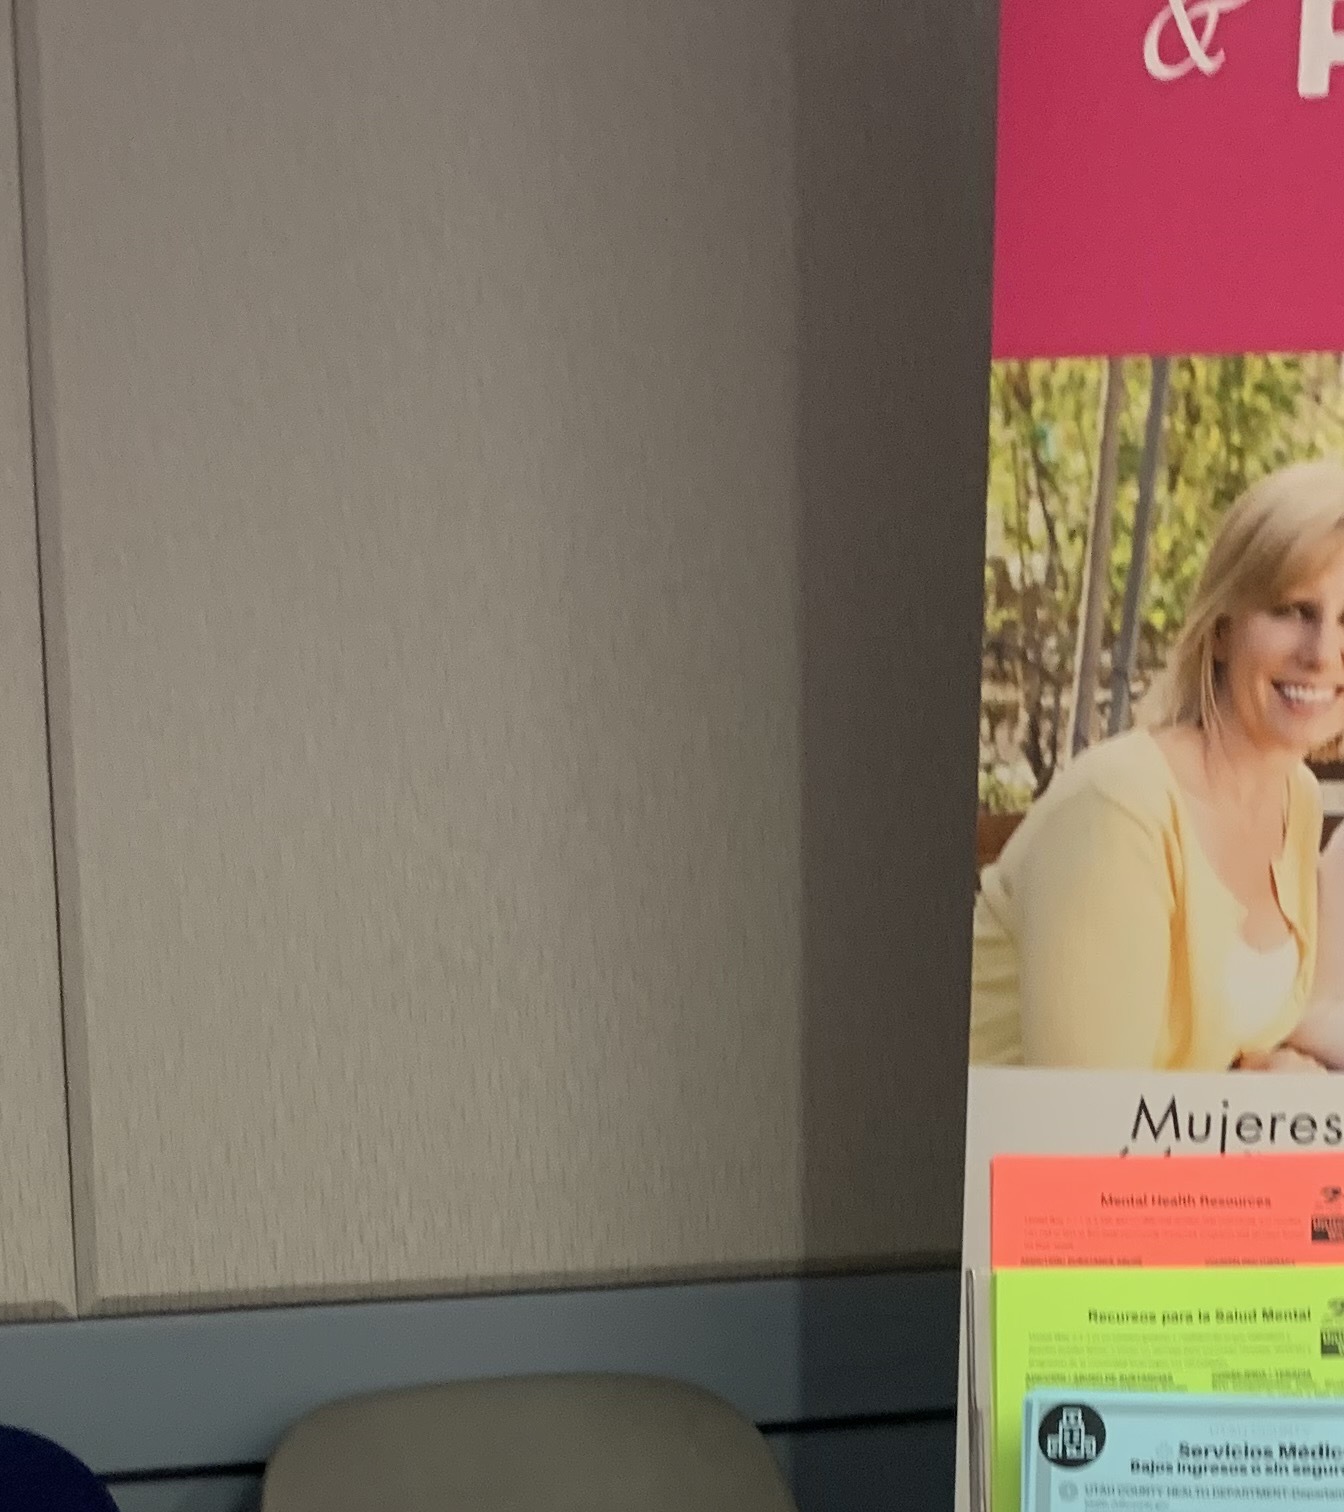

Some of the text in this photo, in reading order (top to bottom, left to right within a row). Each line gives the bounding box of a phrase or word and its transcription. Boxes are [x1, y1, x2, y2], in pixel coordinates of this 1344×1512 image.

[1130, 1094, 1344, 1156] Mujeres
[1162, 1309, 1194, 1327] para
[1261, 1307, 1312, 1323] Mental
[1179, 1440, 1274, 1460] Servicios
[1130, 1458, 1174, 1478] Bajos
[1177, 1461, 1248, 1480] ingresos
